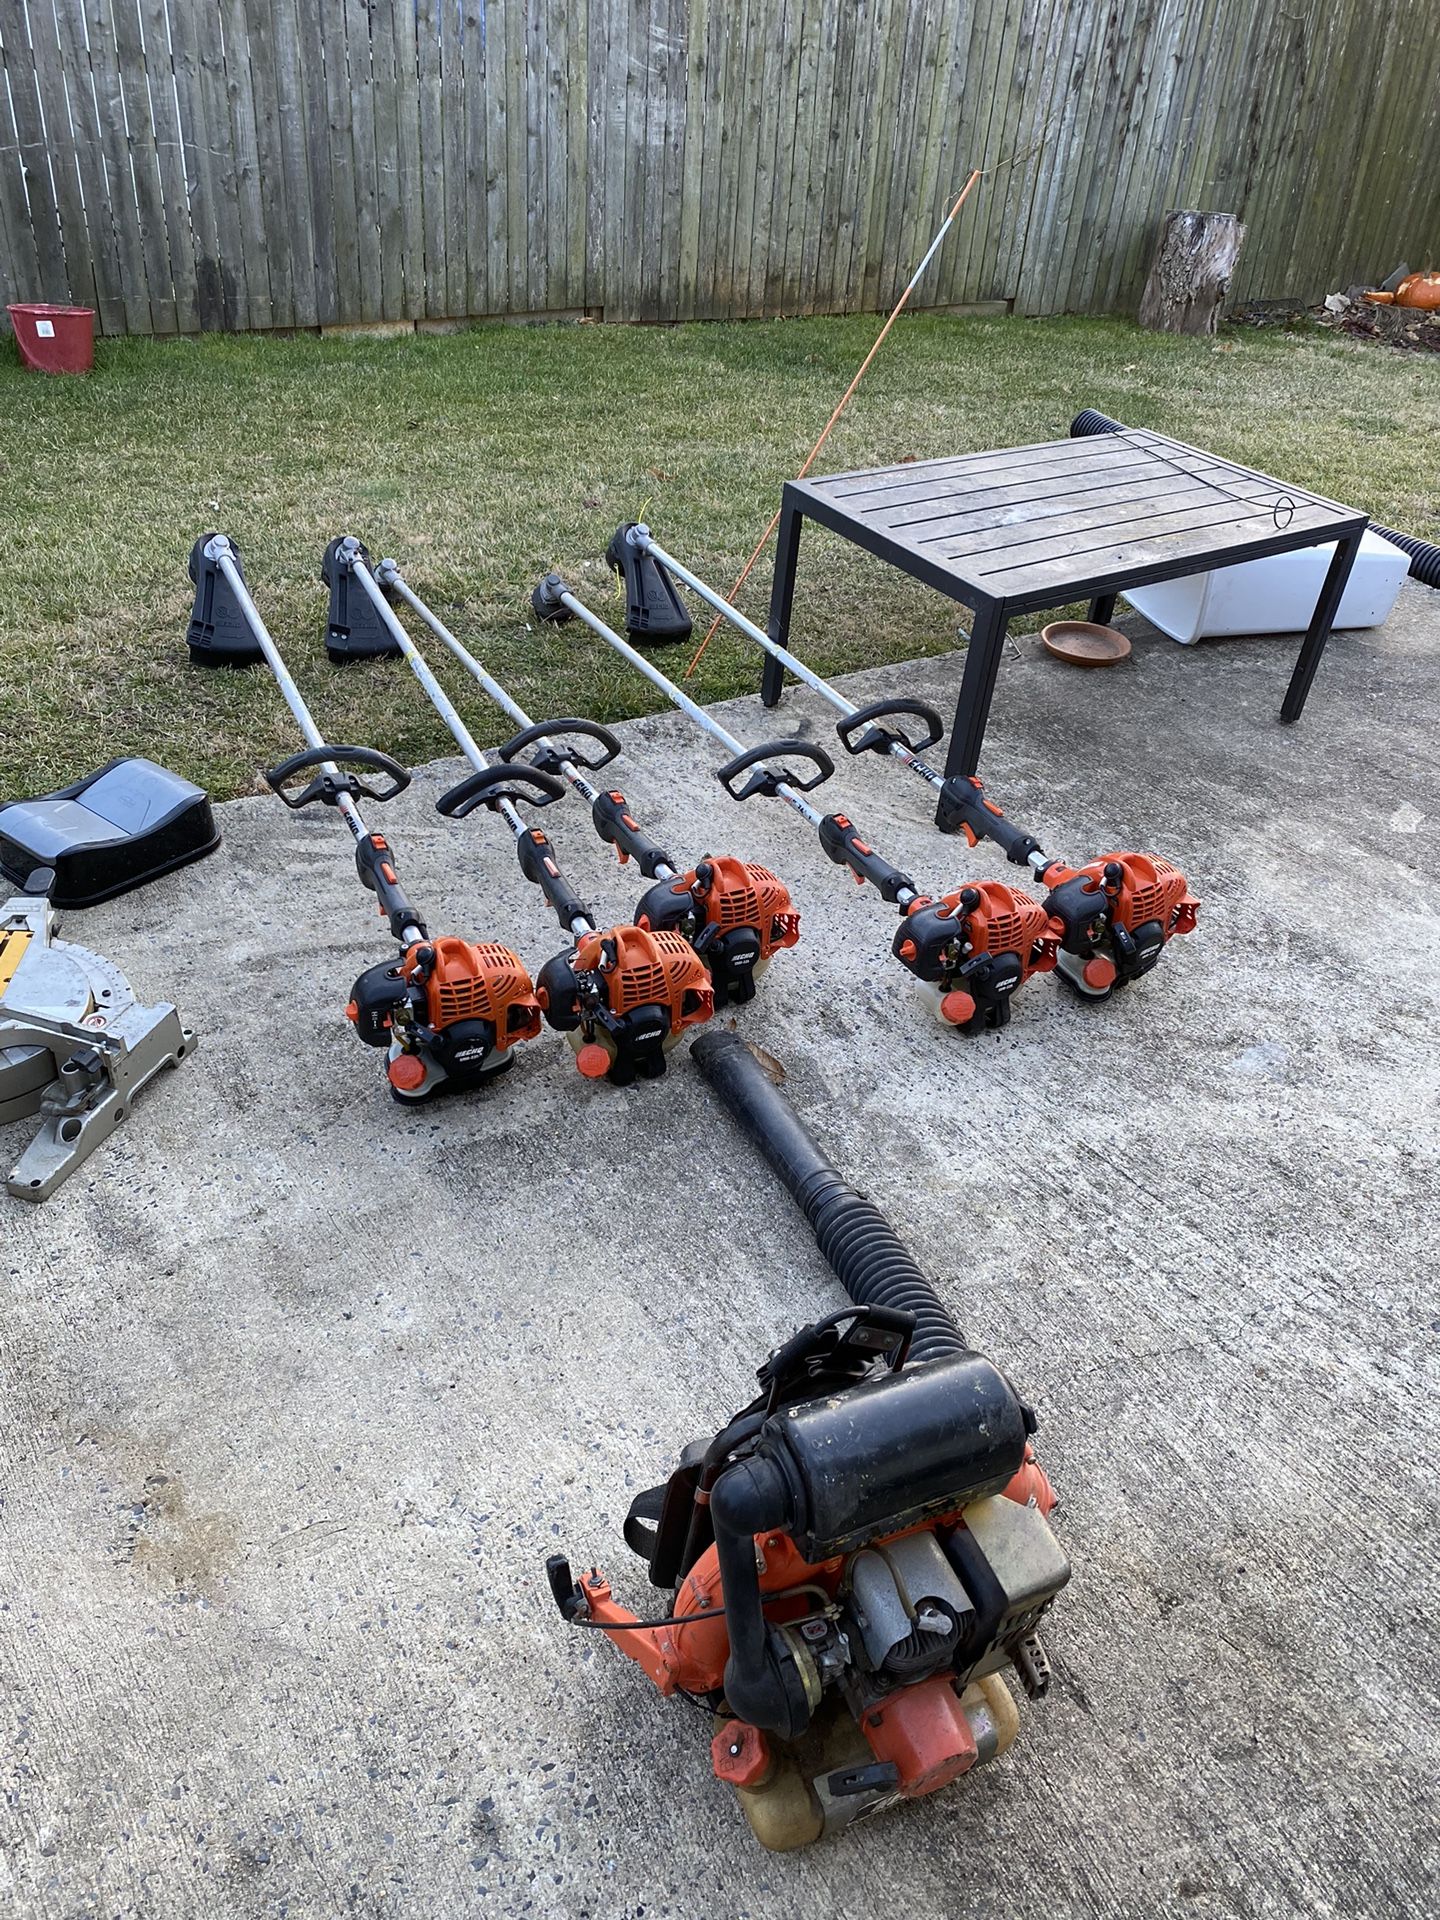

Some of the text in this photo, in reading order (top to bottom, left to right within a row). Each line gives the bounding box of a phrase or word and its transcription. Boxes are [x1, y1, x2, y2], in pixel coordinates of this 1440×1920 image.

[908, 759, 937, 782] ECHO
[573, 778, 594, 800] ECHO
[343, 810, 360, 835] ECHO
[501, 808, 518, 832] ECHO
[733, 952, 755, 961] ECHO
[638, 1029, 662, 1040] ECHO
[457, 1046, 485, 1057] ECHO
